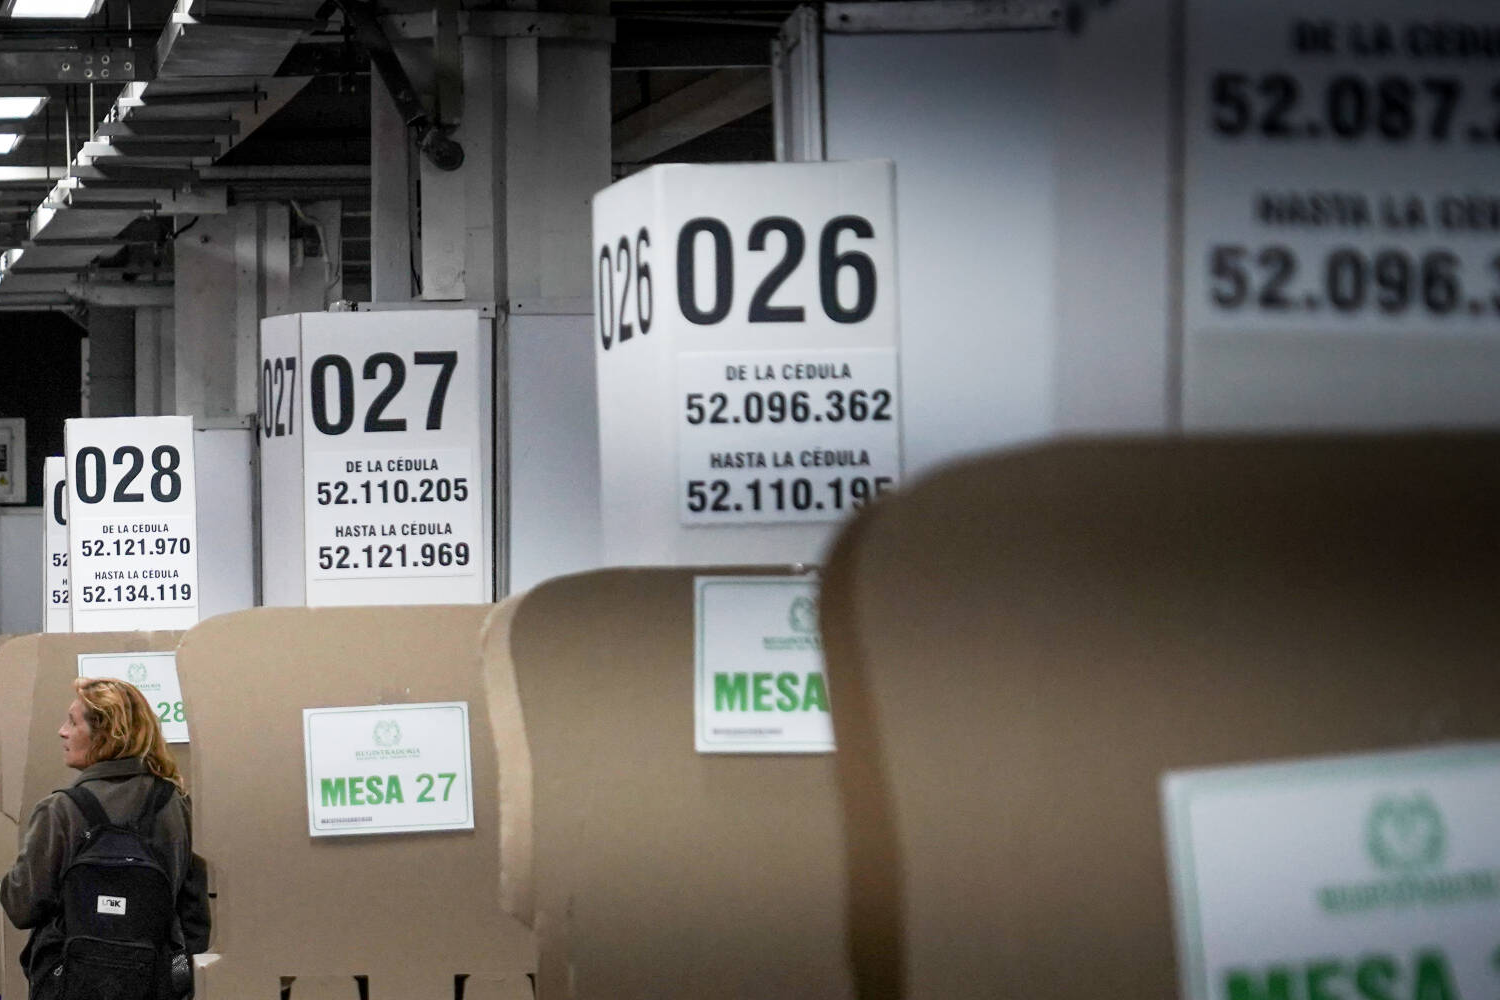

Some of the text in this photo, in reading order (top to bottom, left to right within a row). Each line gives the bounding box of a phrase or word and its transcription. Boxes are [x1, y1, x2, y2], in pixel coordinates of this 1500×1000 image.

[1211, 72, 1500, 142] 52.087.
[675, 213, 879, 327] 026
[1209, 246, 1500, 316] 52.096.
[598, 226, 654, 352] 026
[725, 365, 747, 382] DE
[755, 365, 776, 381] LA
[263, 356, 297, 439] 027
[309, 349, 459, 437] 027
[686, 389, 892, 425] 52.096.362
[74, 443, 183, 506] 028
[346, 456, 439, 473] DE LA CÉDULA
[710, 452, 767, 469] HASTA
[772, 451, 795, 469] LA
[317, 477, 469, 506] 52.110.205
[102, 525, 114, 534] DE
[117, 524, 129, 534] LA
[335, 520, 453, 538] HASTA LA CÉDULA
[81, 537, 191, 557] 52.121.970
[319, 542, 470, 570] 52.121.969
[94, 570, 125, 580] HASTA
[127, 570, 139, 580] LA
[83, 583, 192, 603] 52.134.119
[712, 668, 830, 715] MESA
[320, 772, 457, 807] MESA 27
